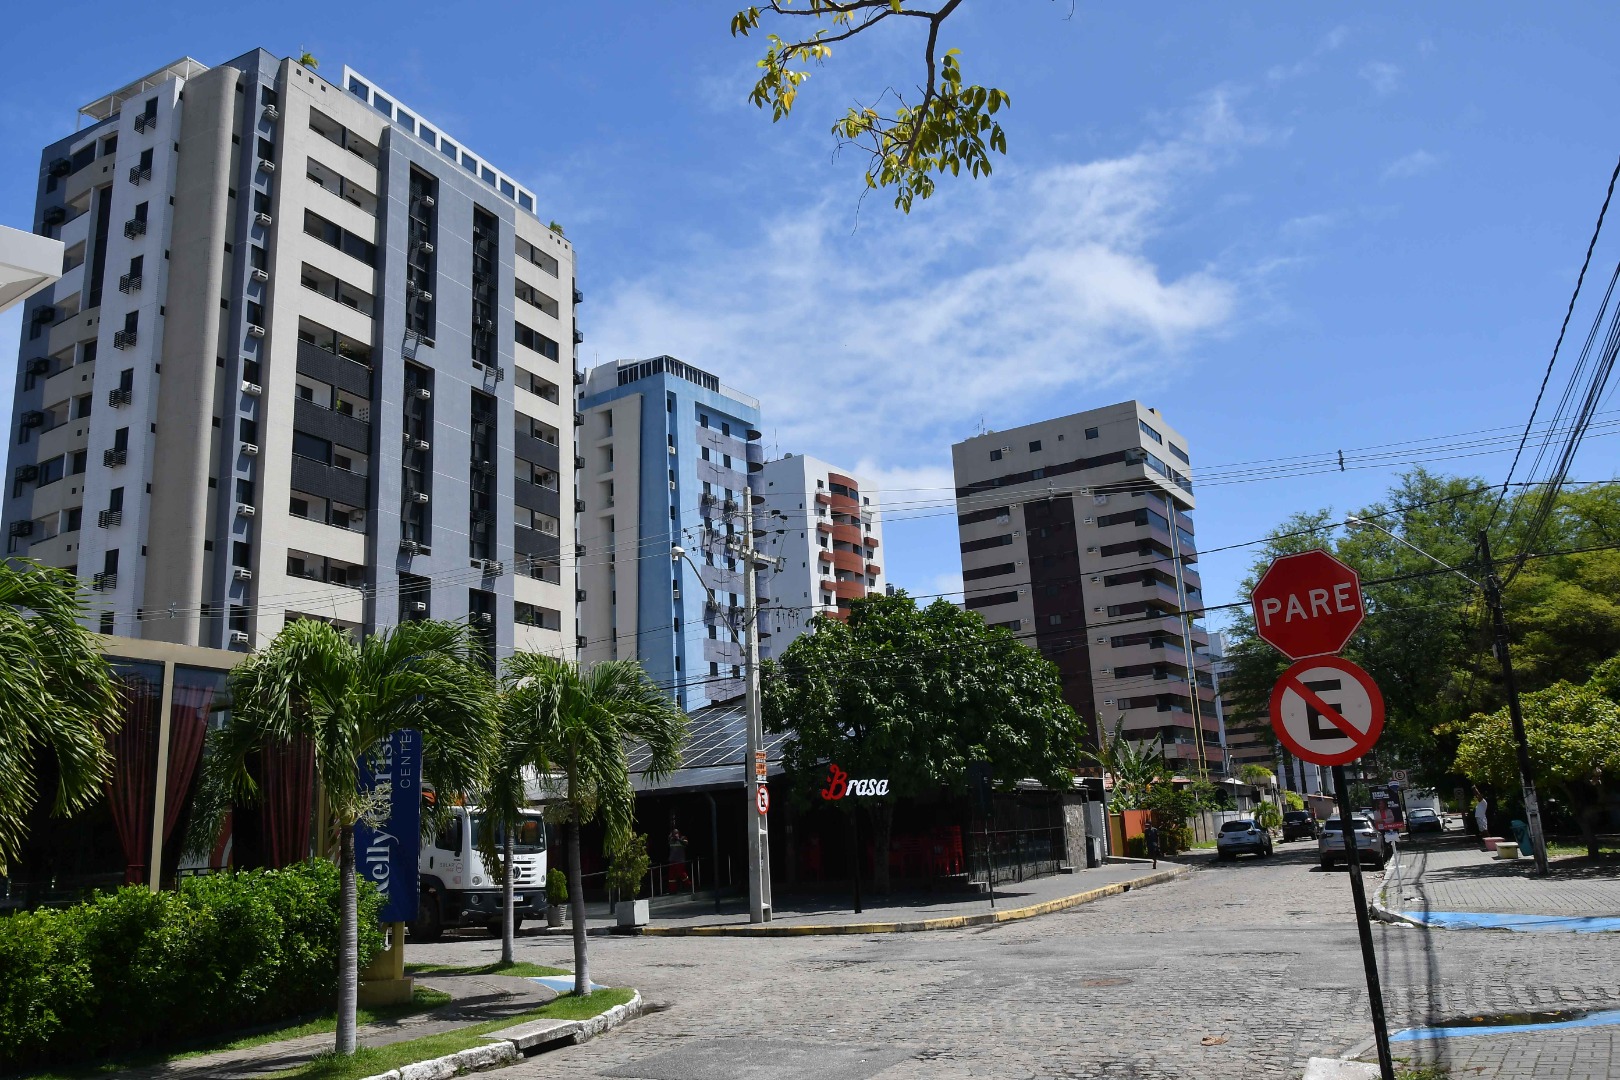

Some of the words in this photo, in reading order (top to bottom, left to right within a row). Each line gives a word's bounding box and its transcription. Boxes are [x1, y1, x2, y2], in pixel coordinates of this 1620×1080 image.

[1262, 582, 1356, 627] PARE
[1303, 679, 1348, 741] E
[821, 763, 889, 800] Brasa
